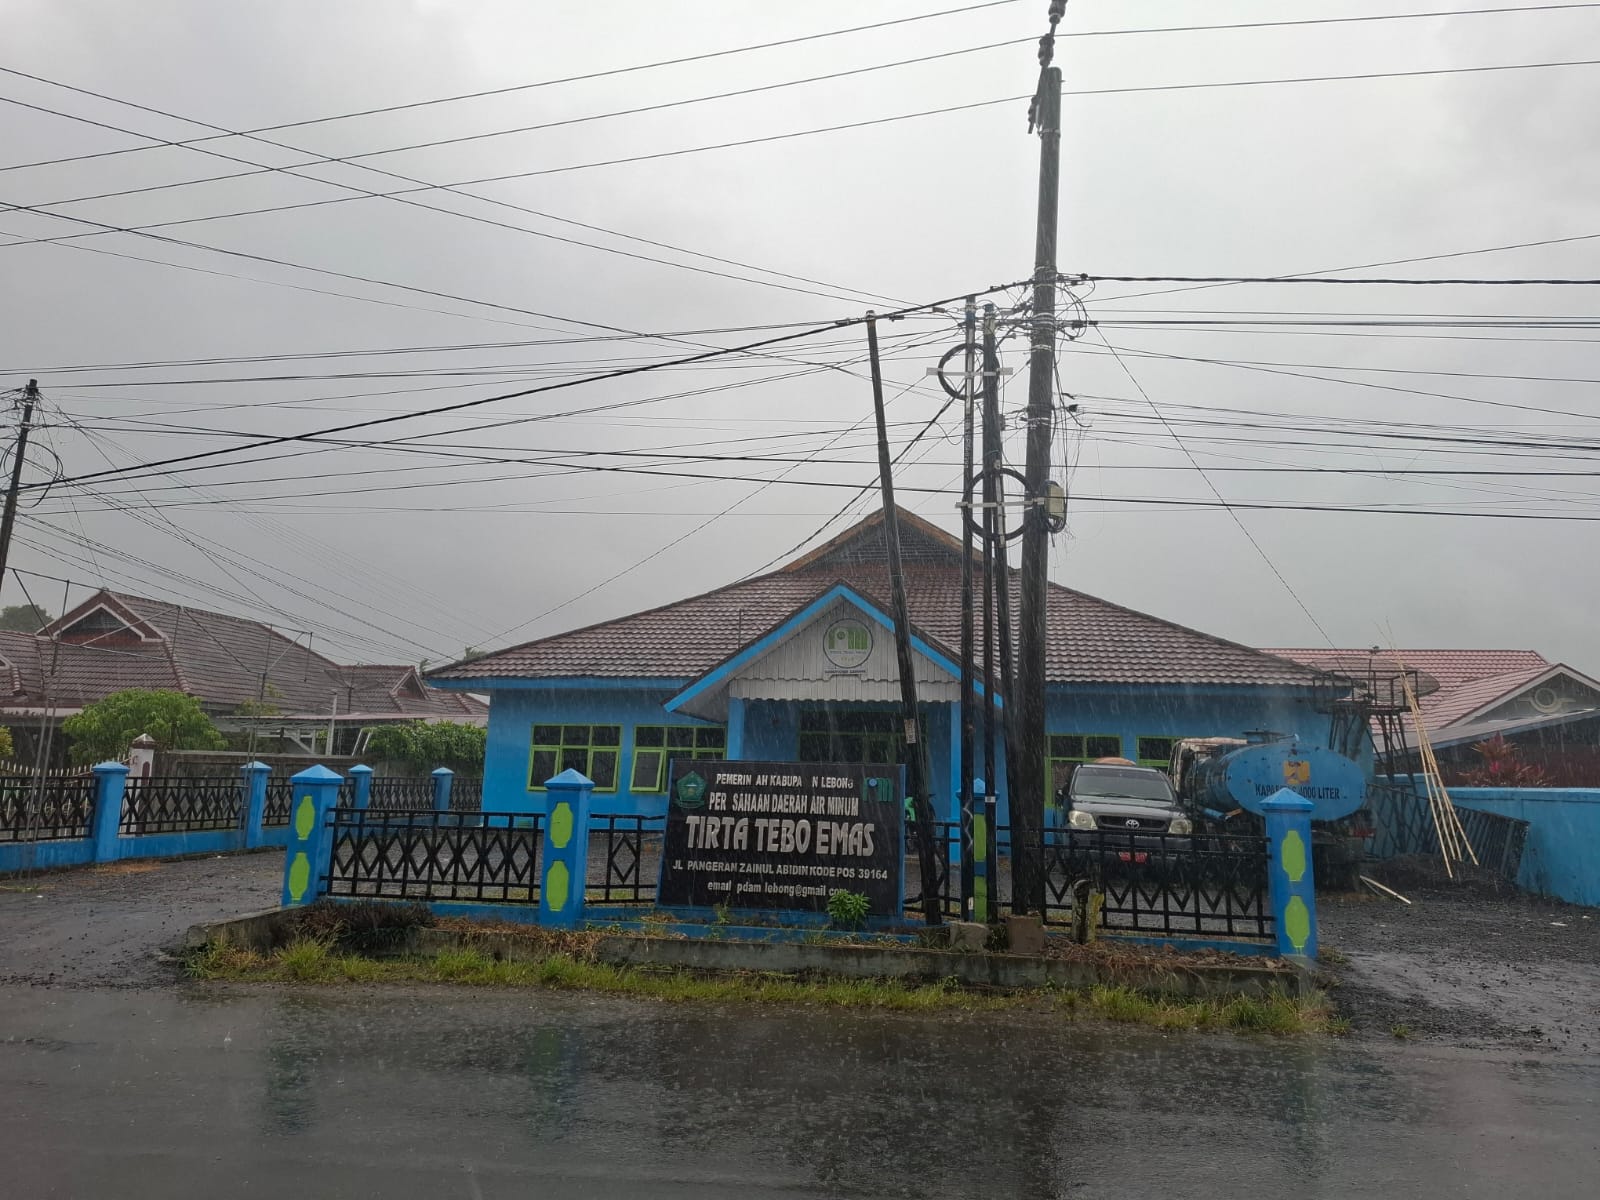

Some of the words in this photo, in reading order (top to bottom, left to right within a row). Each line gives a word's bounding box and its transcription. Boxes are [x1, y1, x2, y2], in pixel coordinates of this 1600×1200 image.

[716, 773, 768, 786] PEMERINAH
[770, 775, 818, 788] KABUPAN
[1318, 786, 1340, 800] LITER
[709, 792, 771, 812] PERSAHAAN
[772, 794, 808, 814] DAERAH
[810, 795, 826, 815] AIR
[827, 796, 859, 816] MINUM
[686, 815, 749, 850] TIRTA
[754, 818, 811, 854] TEBO
[816, 821, 875, 857] EMAS
[687, 860, 737, 873] PANGERAN
[739, 863, 774, 875] ZAINUL
[776, 865, 808, 876] ABIDIN
[809, 866, 835, 878] KODE
[836, 867, 855, 879] POS
[858, 868, 888, 880] 39164
